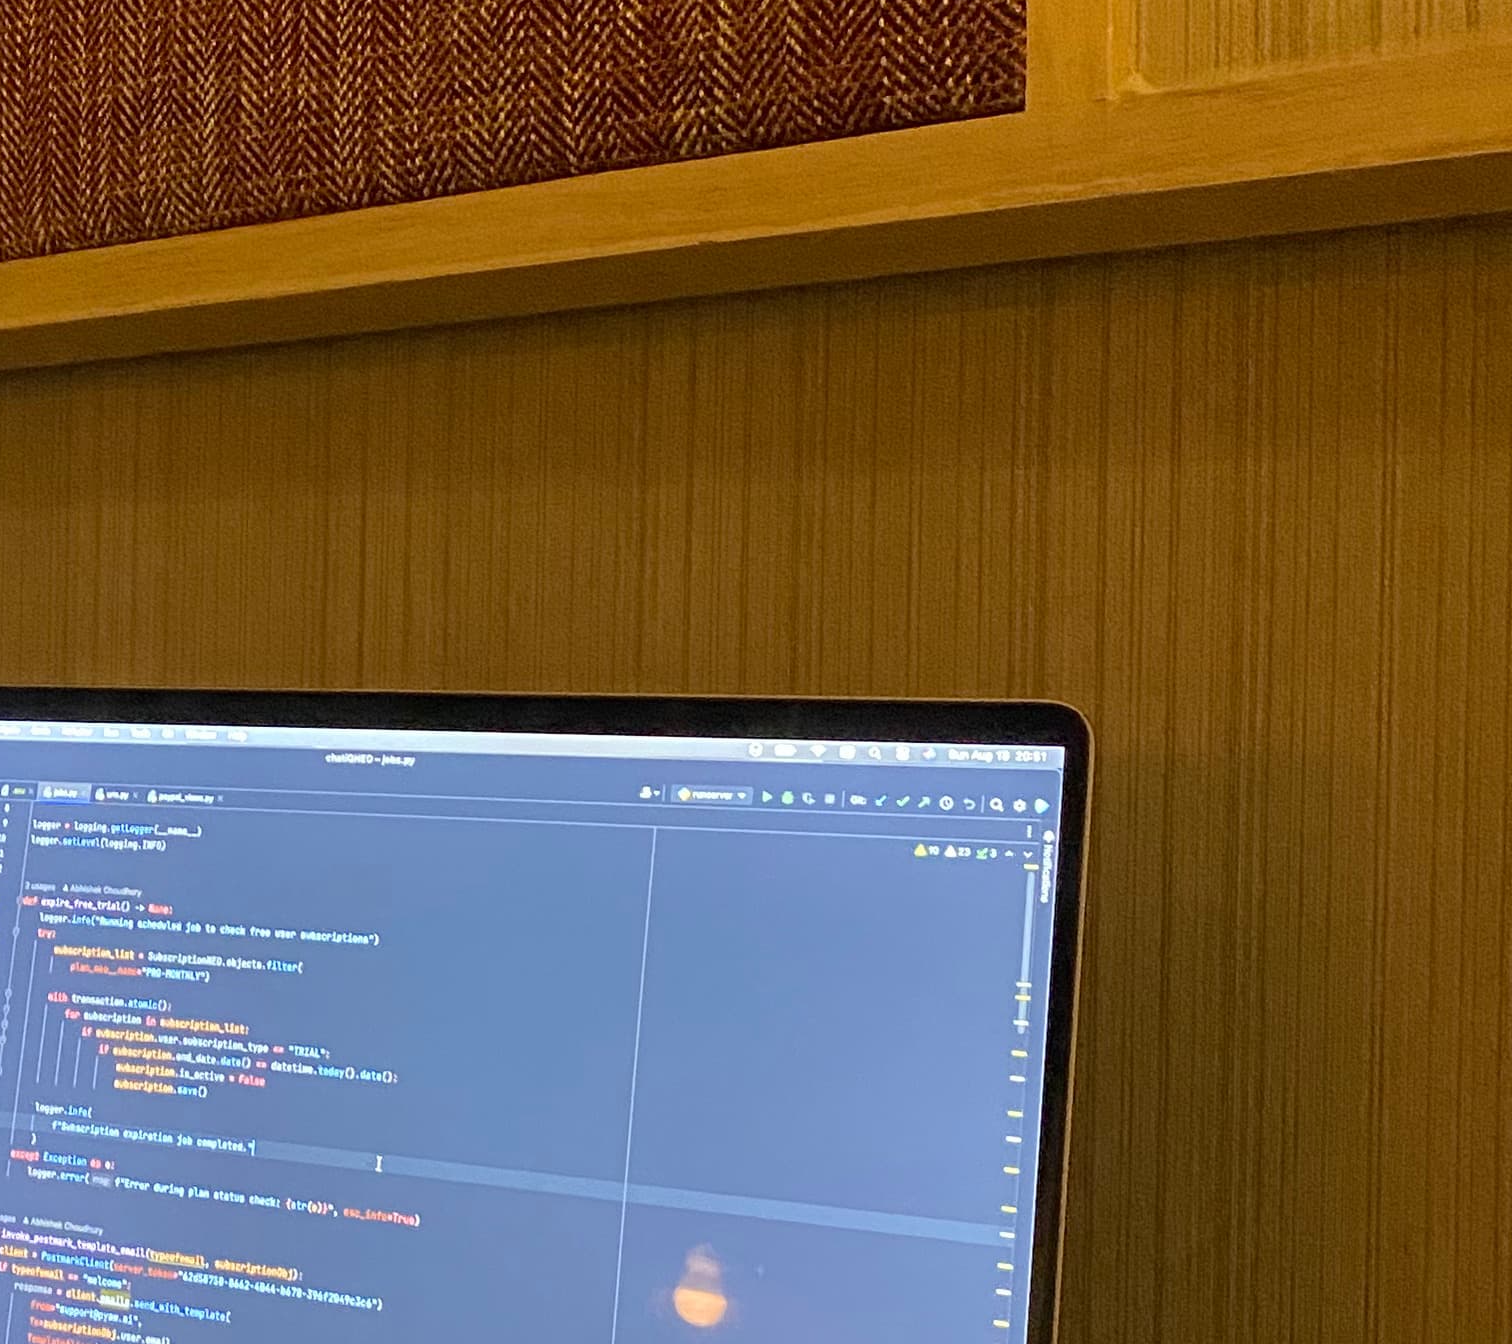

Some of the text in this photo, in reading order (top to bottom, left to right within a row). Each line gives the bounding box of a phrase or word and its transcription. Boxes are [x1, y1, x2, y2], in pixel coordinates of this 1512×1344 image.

[33, 819, 61, 832] logger
[40, 897, 130, 913] expire_free_trial()
[137, 917, 182, 932] scheduled
[185, 921, 202, 934] job
[205, 923, 216, 934] to
[219, 924, 246, 937] check
[249, 926, 271, 939] free
[274, 929, 297, 940] user
[53, 944, 135, 961] subscription_list
[64, 1008, 81, 1019] for
[83, 1010, 142, 1025] subscription
[35, 1101, 93, 1119] logger.info(
[123, 1129, 174, 1145] expiration
[176, 1134, 193, 1147] job
[42, 1151, 87, 1167] Exception
[27, 1165, 90, 1185] logger.error(
[153, 1182, 185, 1198] during
[188, 1185, 210, 1199] plan
[213, 1189, 245, 1204] status
